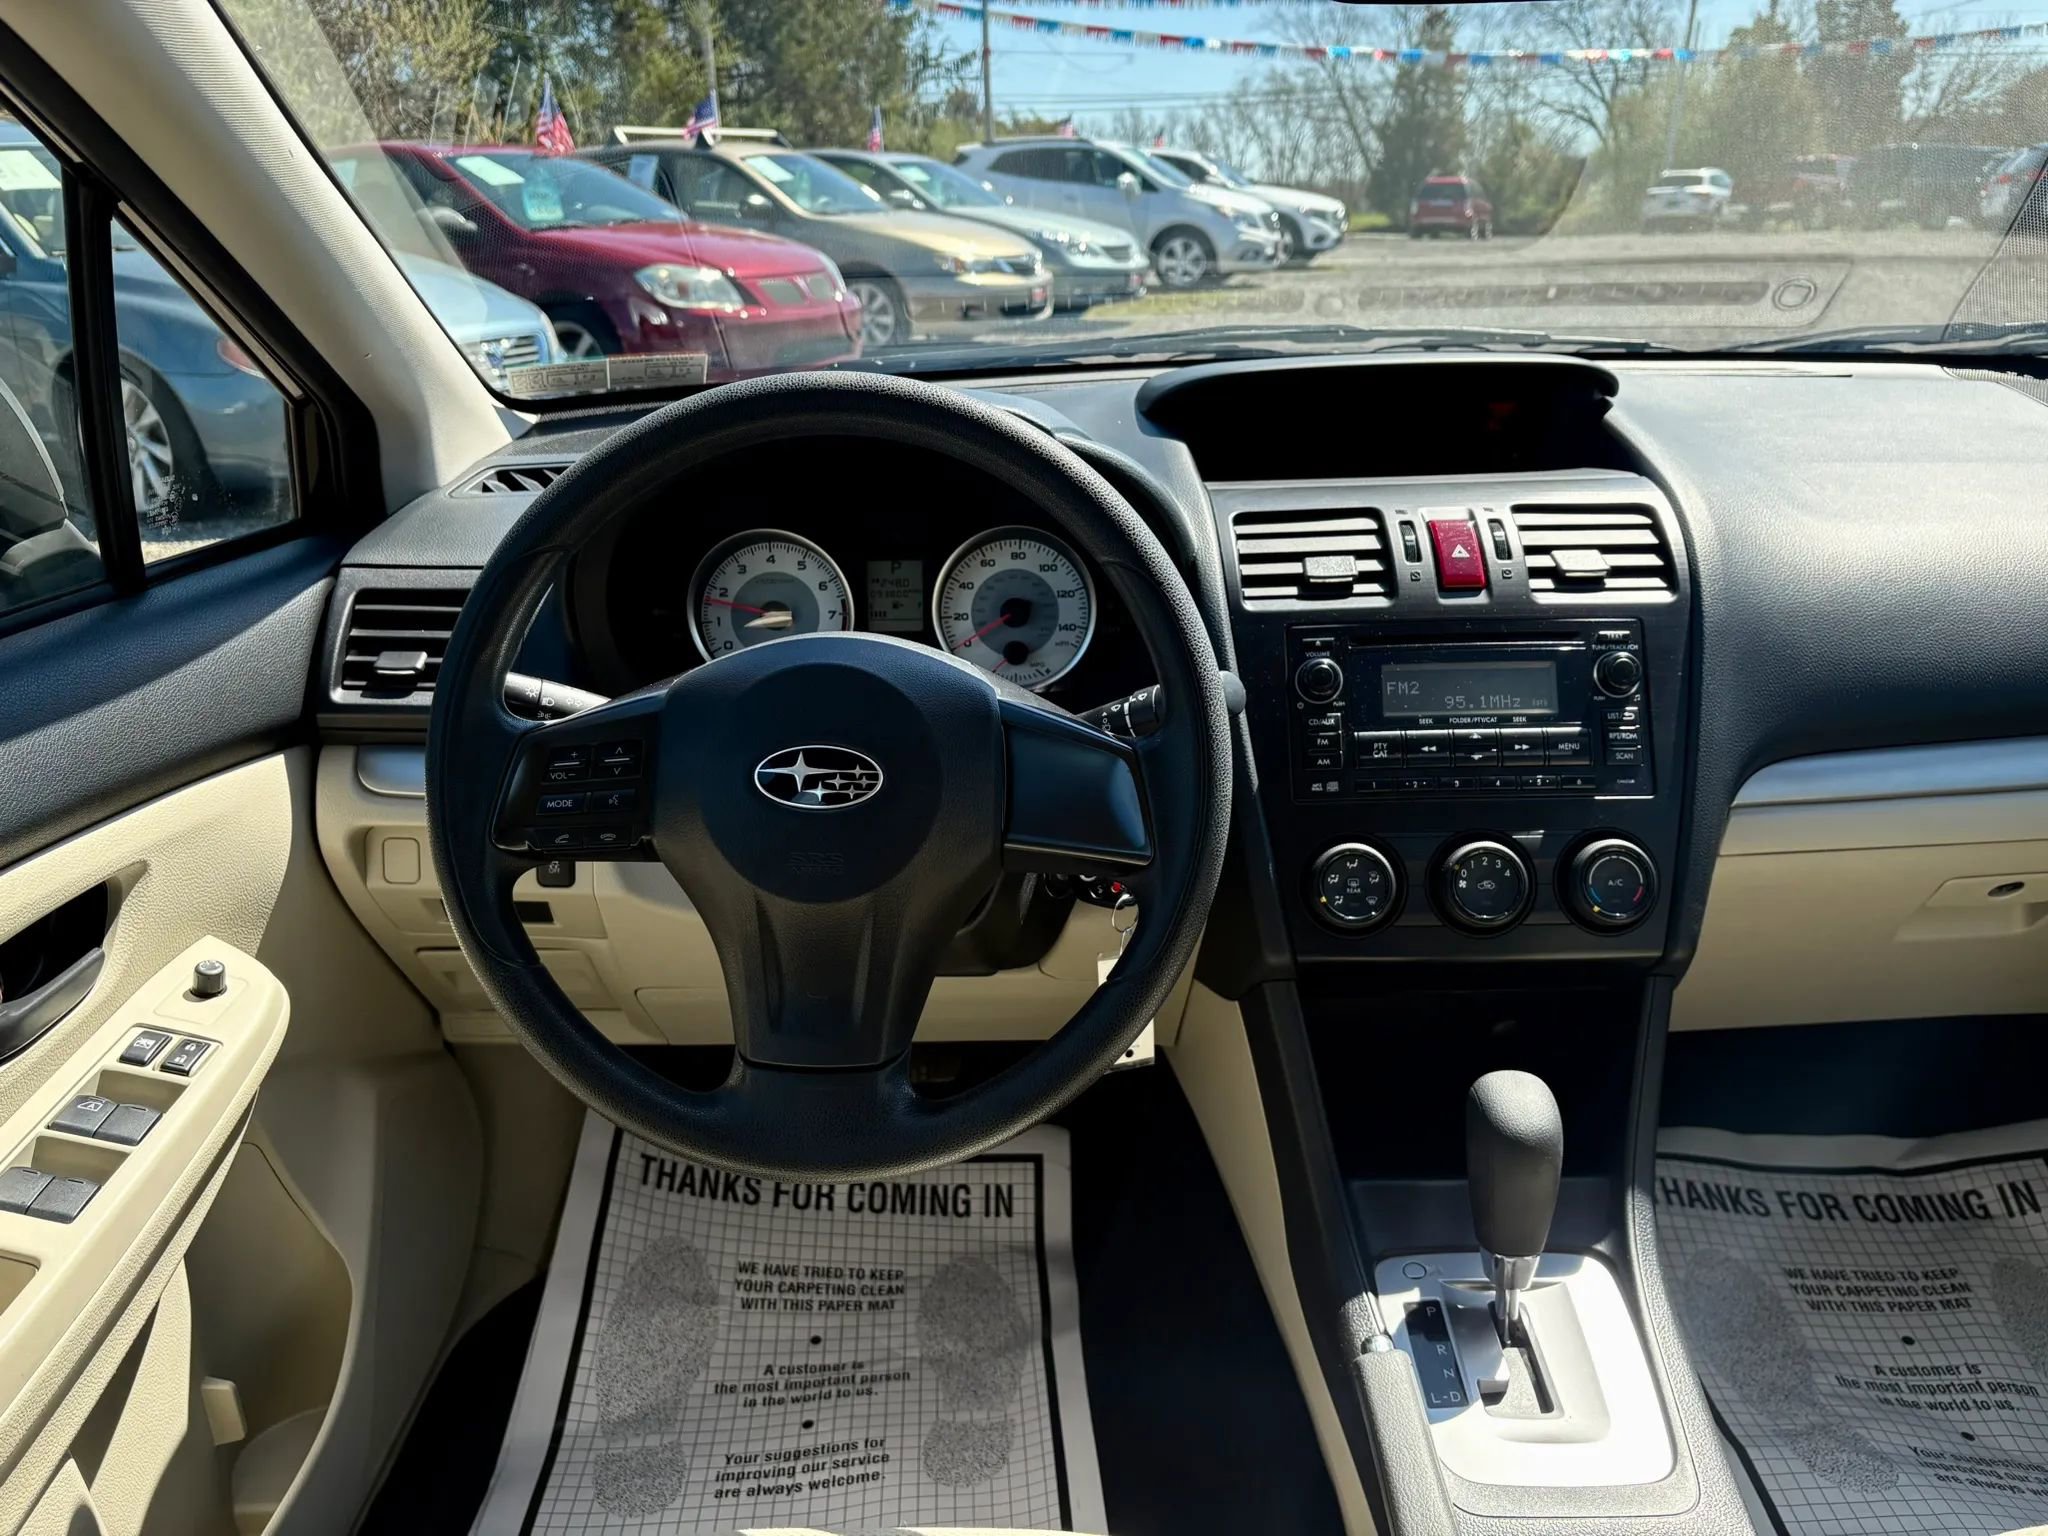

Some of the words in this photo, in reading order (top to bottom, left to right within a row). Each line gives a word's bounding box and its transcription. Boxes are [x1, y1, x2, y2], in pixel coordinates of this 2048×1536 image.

[766, 555, 776, 564] 4
[1011, 552, 1026, 560] 80
[797, 561, 807, 570] 5
[891, 560, 901, 574] P
[980, 559, 996, 567] 60
[1039, 564, 1058, 572] 100
[737, 565, 747, 574] 3
[818, 581, 828, 591] 6
[959, 582, 974, 590] 40
[719, 588, 728, 597] 2
[1057, 590, 1075, 598] 120
[828, 610, 837, 619] 7
[953, 613, 969, 621] 20
[1058, 623, 1077, 632] 140
[723, 641, 733, 650] 0
[1386, 681, 1420, 695] FM2
[1444, 695, 1521, 709] 95.1MHz
[1308, 718, 1335, 726] CD/AUX
[1317, 738, 1329, 746] FM
[1373, 742, 1388, 750] PTY
[1558, 742, 1580, 751] MENU
[1372, 750, 1388, 758] CAT
[1615, 752, 1634, 760] SCAN
[1316, 758, 1330, 766] AM
[550, 771, 567, 780] VOL
[547, 799, 573, 808] MODE
[1608, 878, 1623, 887] A/C
[1347, 886, 1361, 894] REAR
[641, 1153, 761, 1205] THANKS
[773, 1181, 835, 1211] FOR
[847, 1182, 971, 1218] COMING
[984, 1183, 1013, 1218] IN
[1654, 1177, 1771, 1217] HANKS
[1775, 1190, 1849, 1222] FOR
[1852, 1188, 1992, 1224] COMING
[1997, 1180, 2042, 1218] IN
[738, 1261, 759, 1275] WE
[763, 1262, 799, 1277] HAVE
[803, 1265, 844, 1279] TRIED
[848, 1267, 865, 1280] TO
[869, 1268, 904, 1281] KEEP
[1783, 1266, 1808, 1279] WE
[1811, 1267, 1852, 1281] HAVE
[1852, 1269, 1897, 1282] TRIED
[1900, 1270, 1920, 1282] TO
[1922, 1267, 1959, 1281] KEEP
[735, 1278, 773, 1293] YOUR
[777, 1280, 856, 1296] CARPETING
[860, 1284, 905, 1297] CLEAN
[1789, 1282, 1835, 1296] YOUR
[1837, 1284, 1920, 1297] CARPETING
[1922, 1282, 1972, 1296] CLEAN
[740, 1296, 777, 1310] WITH
[782, 1298, 813, 1311] THIS
[818, 1299, 863, 1311] PAPER
[867, 1299, 896, 1311] MAT
[1804, 1299, 1846, 1312] WITH
[1850, 1300, 1885, 1312] THIS
[1887, 1300, 1936, 1312] PAPER
[1939, 1297, 1972, 1310] MAT
[1426, 1306, 1437, 1317] P
[1436, 1344, 1447, 1356] R
[763, 1364, 774, 1376] A
[778, 1362, 847, 1375] customer
[852, 1360, 864, 1370] is
[1443, 1368, 1455, 1378] N
[1874, 1364, 1886, 1376] A
[1890, 1363, 1961, 1377] customer
[1965, 1362, 1982, 1375] is
[714, 1382, 738, 1394] the
[742, 1380, 779, 1393] most
[784, 1373, 856, 1391] important
[860, 1371, 911, 1385] person
[1835, 1375, 1861, 1389] the
[1865, 1380, 1902, 1393] most
[1907, 1380, 1984, 1396] important
[1988, 1380, 2040, 1397] person
[743, 1396, 757, 1407] in
[762, 1394, 785, 1407] the
[790, 1389, 832, 1404] world
[837, 1388, 851, 1399] to
[855, 1387, 878, 1397] us.
[1896, 1397, 1921, 1409] the
[1926, 1398, 1971, 1411] world
[1973, 1399, 1990, 1411] to
[1994, 1399, 2021, 1411] us.
[723, 1453, 760, 1465] Your
[764, 1440, 859, 1462] suggestions
[864, 1437, 886, 1449] for
[1908, 1445, 1947, 1460] Your
[715, 1465, 796, 1483] improving
[802, 1460, 827, 1474] our
[832, 1453, 890, 1470] service
[1916, 1458, 2004, 1480] improving
[2004, 1472, 2033, 1483] our
[714, 1486, 741, 1499] are
[746, 1482, 803, 1497] always
[808, 1471, 887, 1491] welcome.
[1934, 1473, 1963, 1485] are
[1965, 1477, 2026, 1495] always
